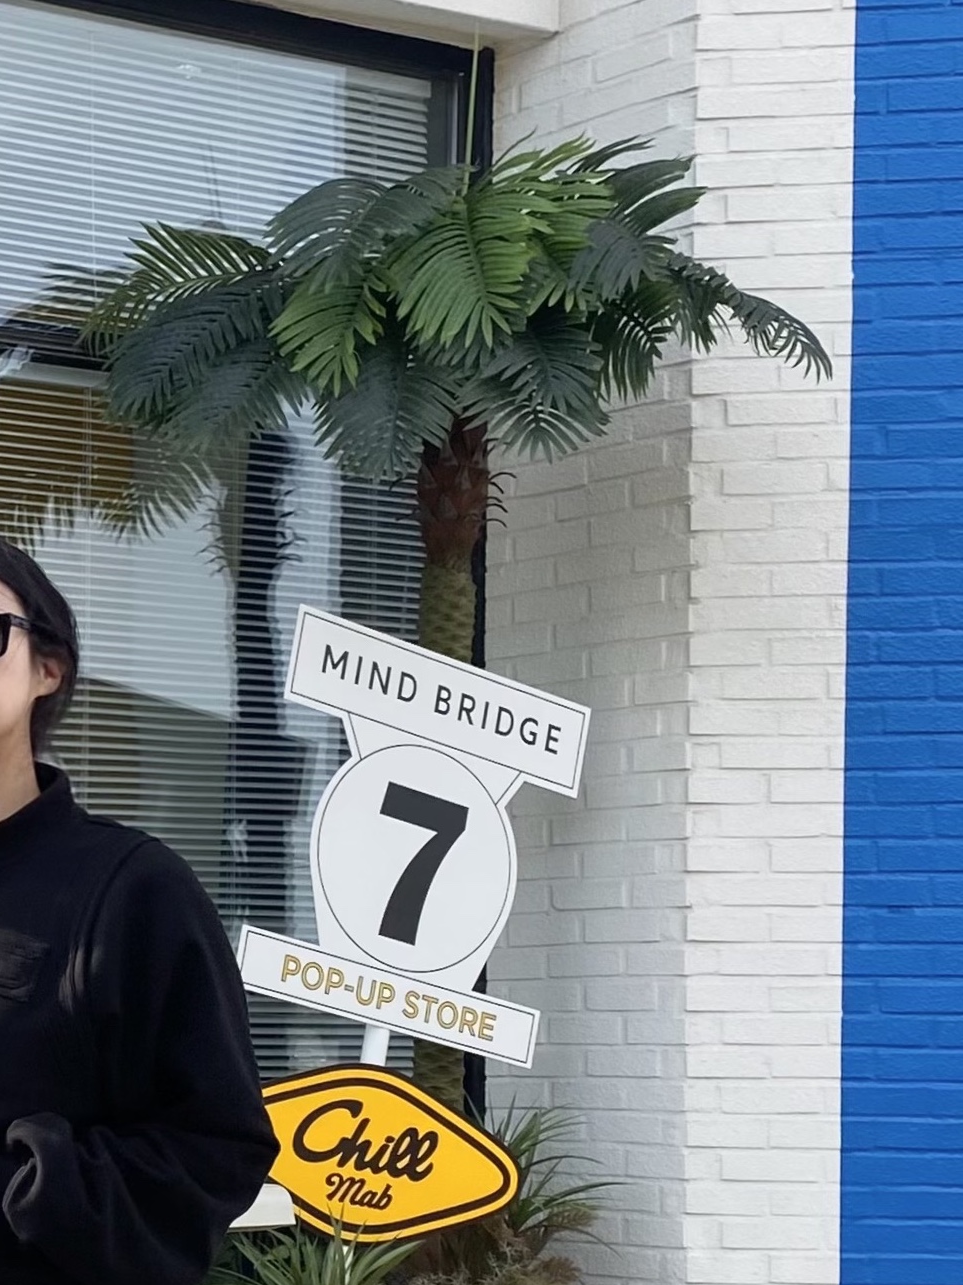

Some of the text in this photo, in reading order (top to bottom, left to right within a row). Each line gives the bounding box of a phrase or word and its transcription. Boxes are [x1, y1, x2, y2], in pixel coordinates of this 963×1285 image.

[321, 644, 562, 755] MIND BRIDGE
[378, 781, 470, 946] 7
[281, 954, 497, 1042] POP-UP STORE
[293, 1099, 439, 1182] Chill
[325, 1173, 393, 1211] Mab
